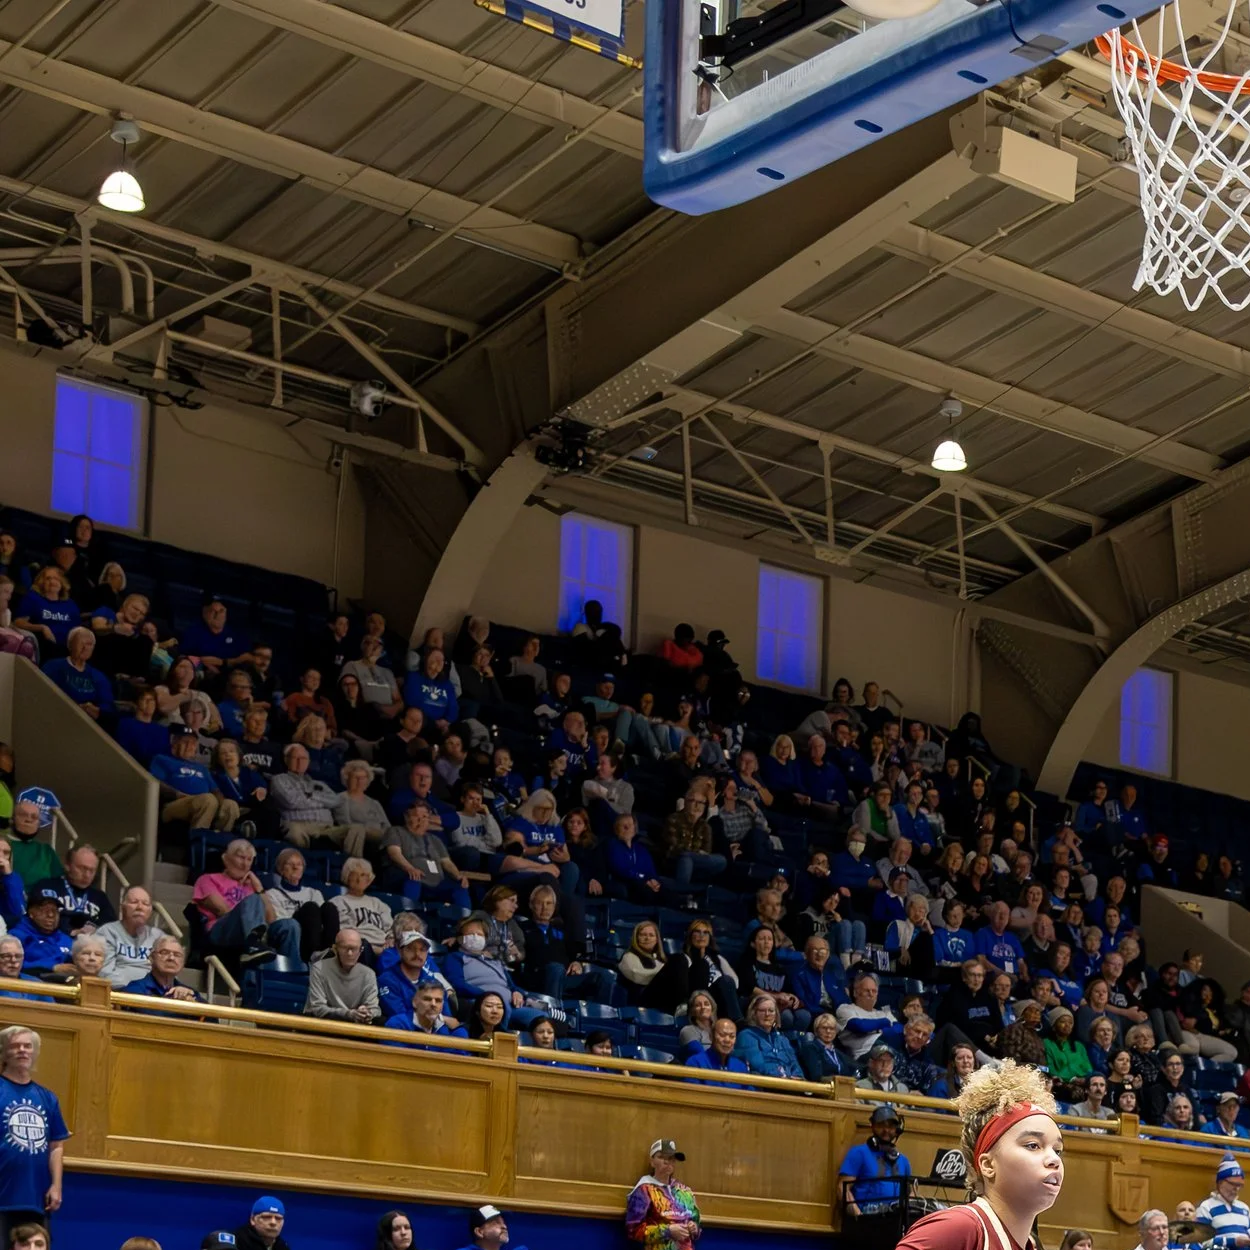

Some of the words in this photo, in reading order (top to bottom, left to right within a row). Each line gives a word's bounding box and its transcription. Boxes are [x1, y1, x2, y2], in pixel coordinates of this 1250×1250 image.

[42, 609, 70, 621] Duke
[118, 943, 153, 959] DUK
[948, 1153, 960, 1164] DJ
[941, 1160, 962, 1173] LIL'D
